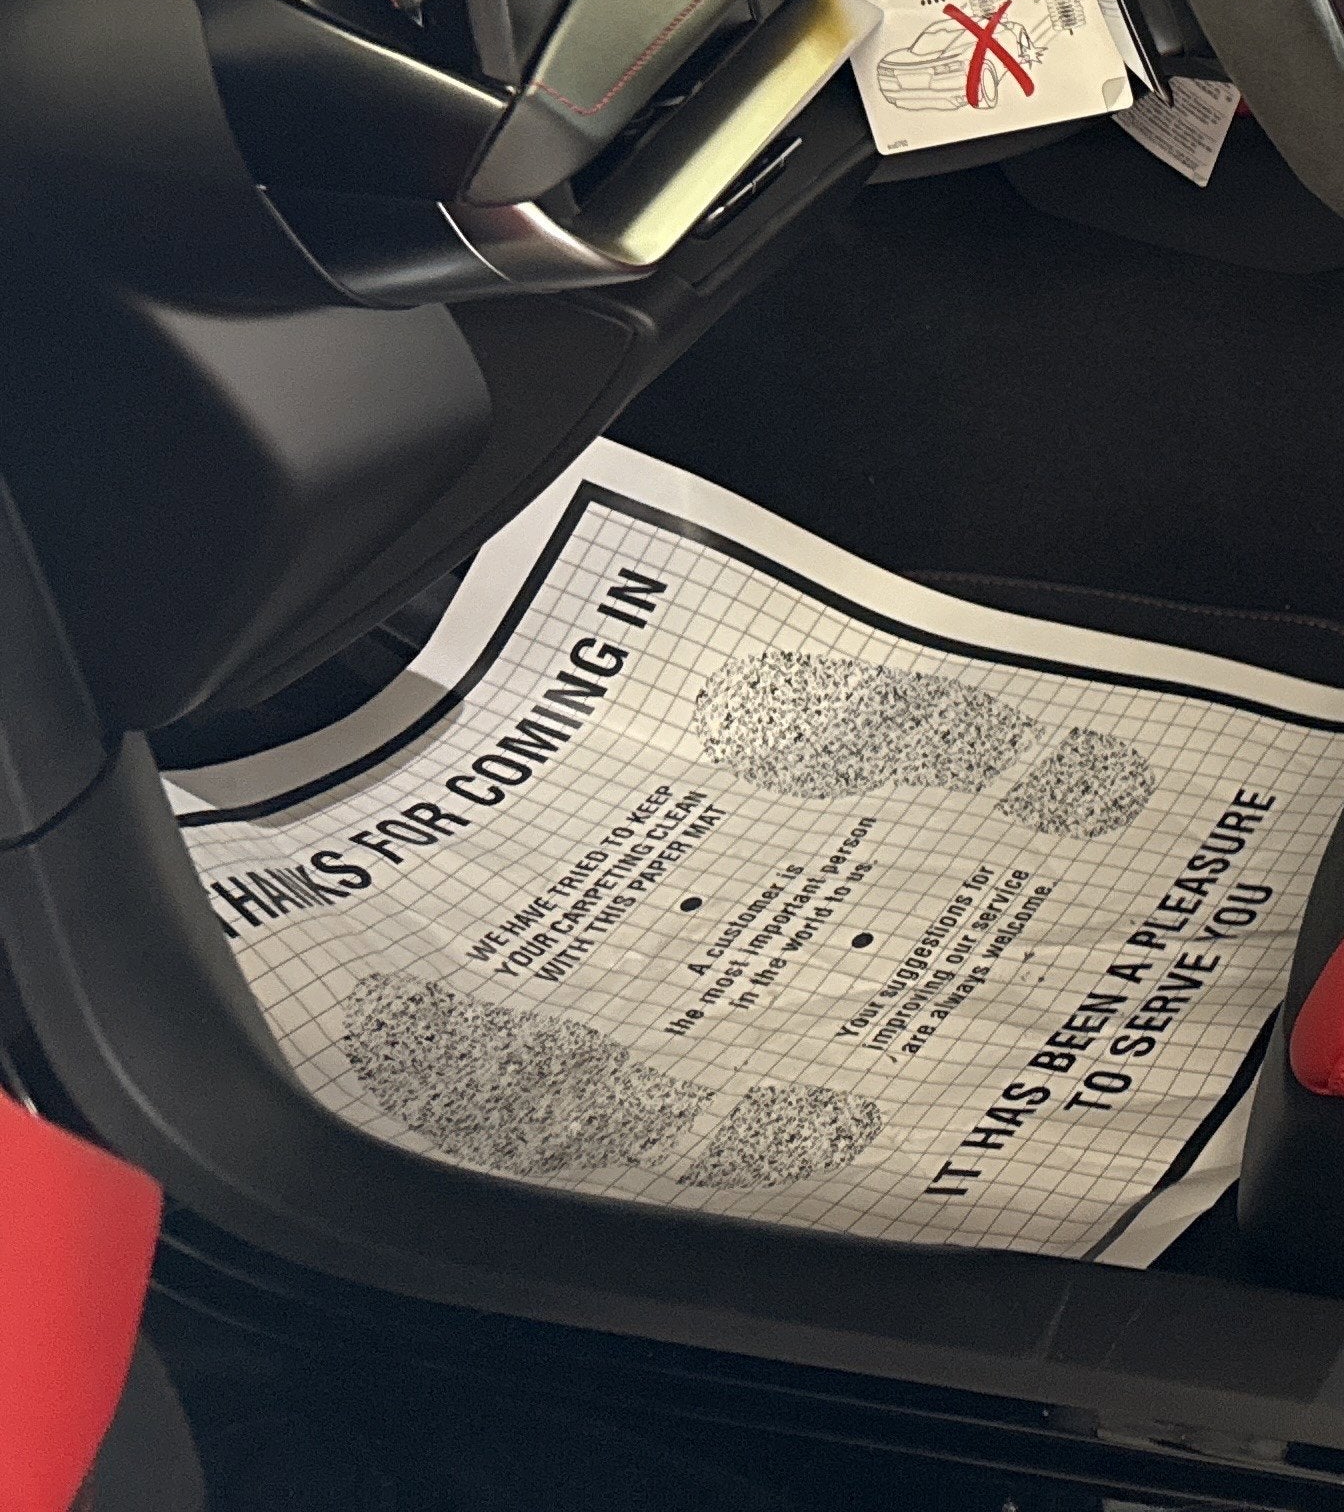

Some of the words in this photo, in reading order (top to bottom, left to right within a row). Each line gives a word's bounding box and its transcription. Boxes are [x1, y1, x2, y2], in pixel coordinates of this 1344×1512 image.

[347, 801, 471, 866] FOR
[444, 636, 631, 807] COMING
[596, 566, 668, 630] IN
[466, 930, 509, 963] WE
[500, 896, 558, 937] HAVE
[549, 849, 609, 897] TRIED
[600, 825, 635, 847] TO
[626, 785, 674, 825] KEEP
[494, 932, 559, 978] YOUR
[550, 843, 655, 935] CARPETING
[646, 790, 708, 840] CLEAN
[533, 937, 595, 983] WITH
[583, 894, 637, 934] THIS
[627, 840, 693, 892] PAPER
[682, 803, 727, 839] MAT
[687, 962, 713, 977] A
[706, 882, 786, 960] customer
[775, 863, 804, 881] is
[700, 959, 750, 1005] most
[740, 876, 828, 956] important
[820, 815, 877, 875] person
[728, 990, 760, 1010] in
[750, 957, 788, 987] the
[780, 905, 834, 953] world
[824, 885, 852, 904] to
[835, 1000, 886, 1038] Your
[879, 893, 974, 999] suggestions
[962, 865, 995, 891] for
[1126, 787, 1277, 950] PLEASURE
[861, 968, 957, 1052] improving
[945, 934, 978, 965] our
[971, 868, 1031, 932] service
[901, 1024, 937, 1055] are
[929, 964, 991, 1021] always
[982, 880, 1059, 960] welcome.
[1028, 991, 1129, 1073] BEEN
[1063, 1069, 1133, 1111] TO
[1110, 952, 1221, 1058] SERVE
[1197, 881, 1274, 943] YOU
[1106, 960, 1153, 985] A
[923, 1161, 982, 1197] IT
[961, 1082, 1052, 1150] HAS
